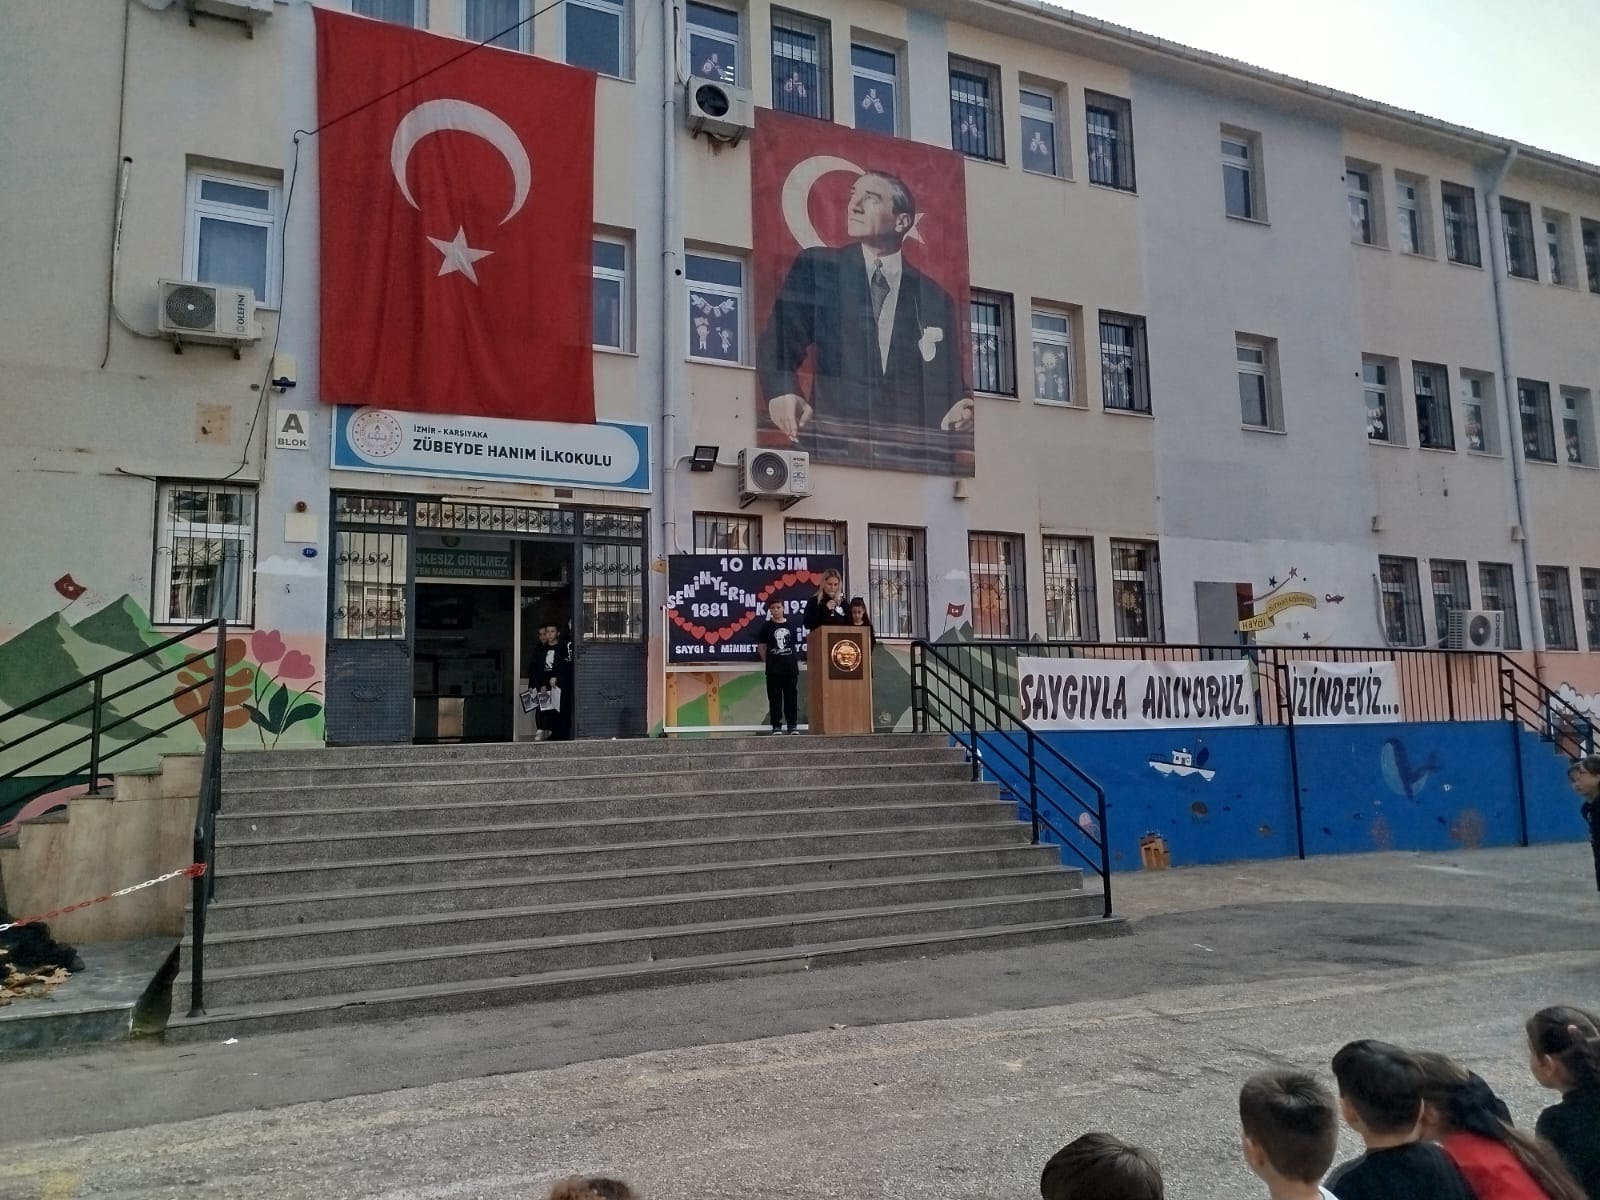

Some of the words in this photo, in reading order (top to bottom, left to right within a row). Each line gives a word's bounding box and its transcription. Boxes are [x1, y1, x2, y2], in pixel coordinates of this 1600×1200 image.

[281, 413, 304, 434] A
[413, 424, 436, 434] İZMİR
[443, 428, 488, 439] KARŞIYAKA
[277, 437, 307, 447] BLOK
[413, 437, 483, 455] ZÜBEYDE
[487, 445, 536, 461] HANIM
[540, 446, 612, 467] İLKOKULU
[415, 552, 455, 566] SKESİZ
[457, 552, 508, 568] GİRİLMEZ
[720, 557, 744, 572] 10
[752, 556, 808, 571] KASIM
[691, 602, 729, 618] 1881
[675, 645, 704, 654] SAYGI
[1021, 673, 1128, 720] SAYGIYLA
[1142, 674, 1249, 720] ANIYORUZ.
